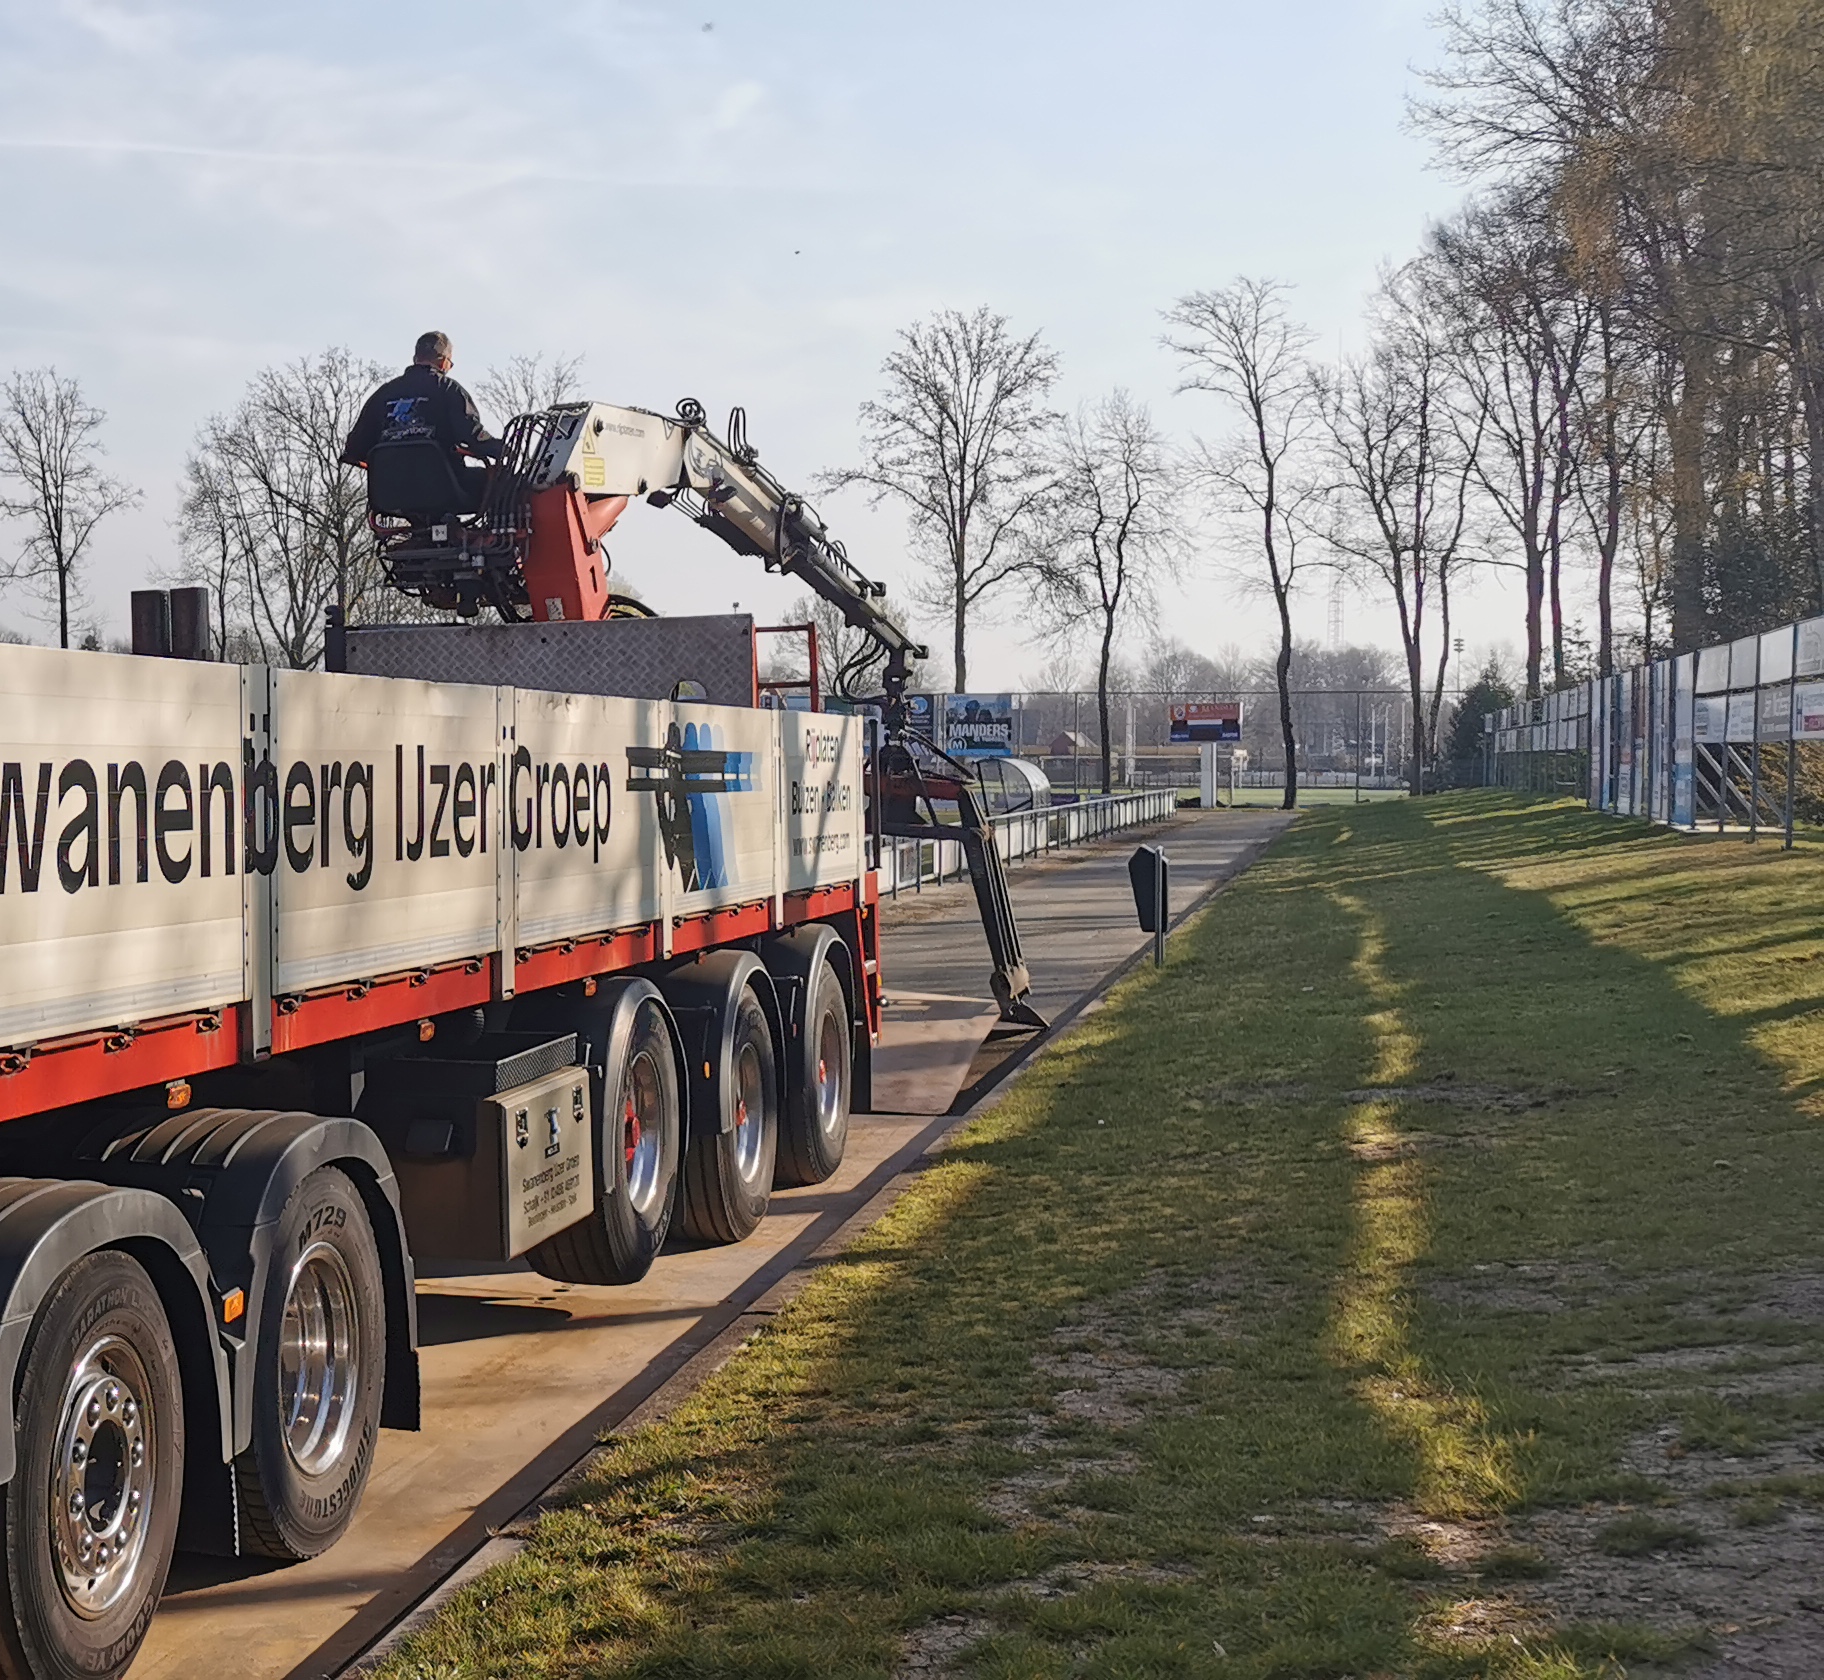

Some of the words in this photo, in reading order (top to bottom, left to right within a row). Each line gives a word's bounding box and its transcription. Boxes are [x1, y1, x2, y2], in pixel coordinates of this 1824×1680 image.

[949, 723, 1009, 737] MANDERS
[395, 744, 496, 862] IJzer
[503, 745, 611, 864] Groep
[298, 1206, 347, 1253] M729
[70, 1287, 128, 1352] MARATHON
[67, 1594, 154, 1672] GOODYEA
